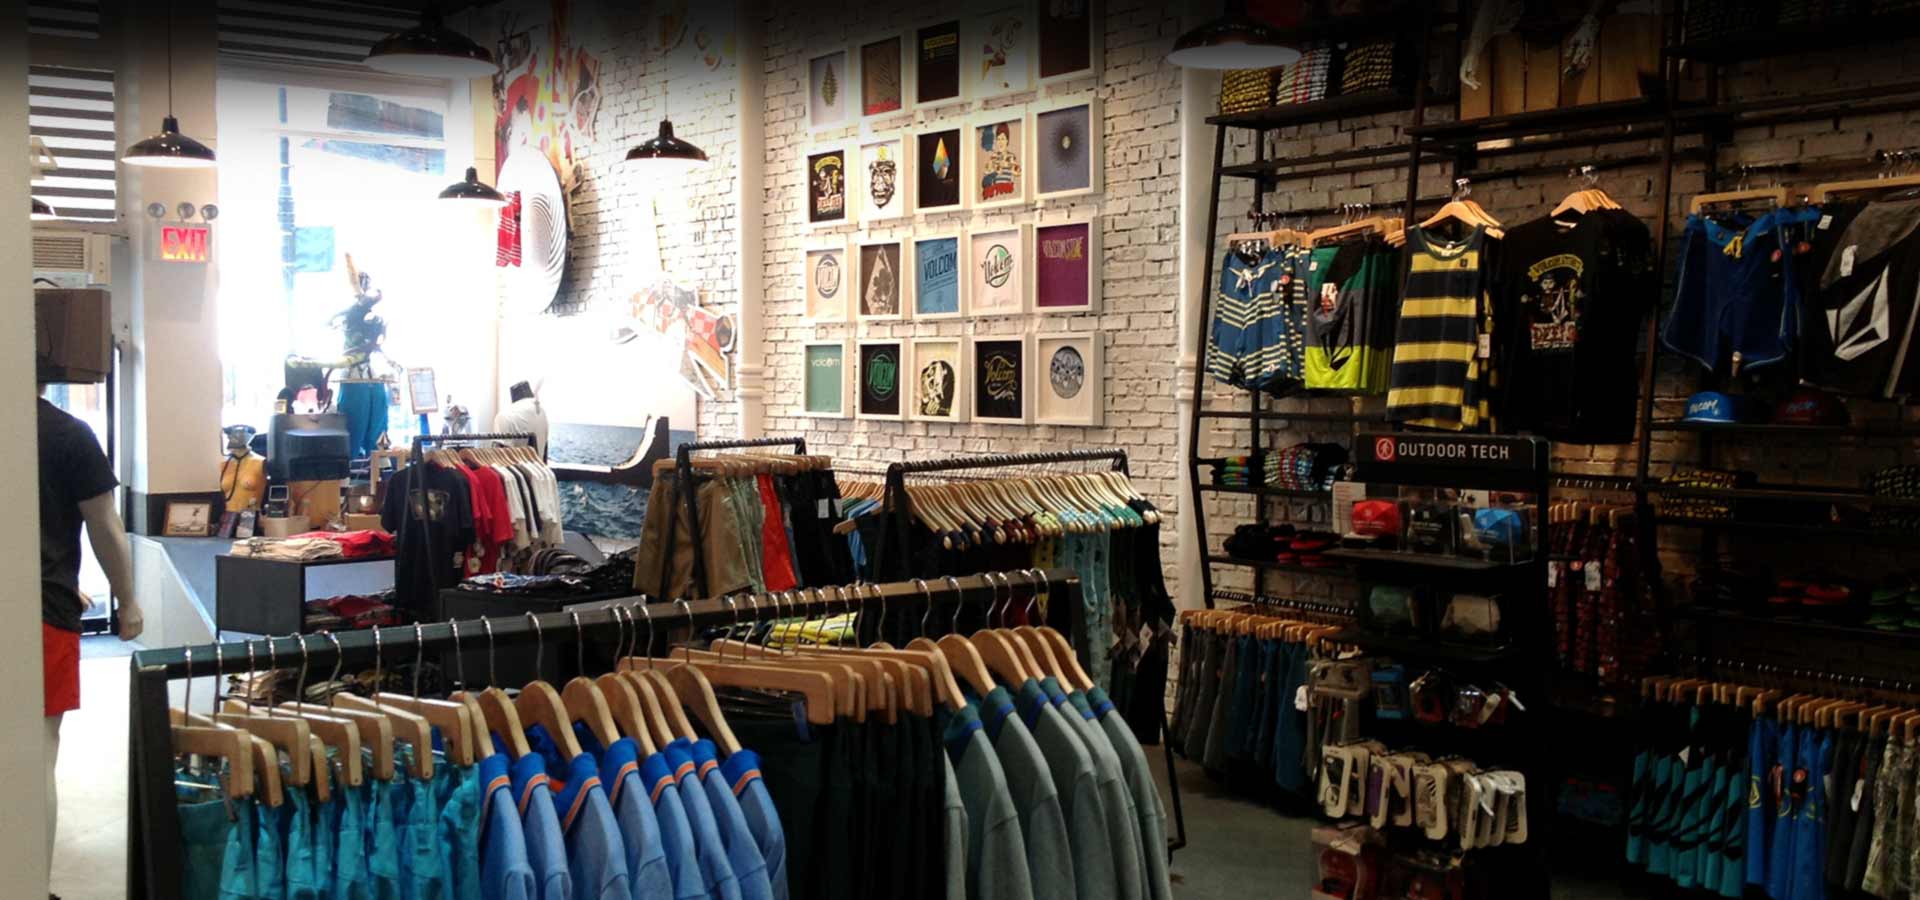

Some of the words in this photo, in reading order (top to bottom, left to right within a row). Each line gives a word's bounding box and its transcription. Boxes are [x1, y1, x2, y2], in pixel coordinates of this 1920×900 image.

[162, 227, 208, 261] EXIT
[924, 252, 957, 281] VOLCOM
[1398, 442, 1466, 458] OUTDOOR
[1472, 445, 1509, 459] TECH
